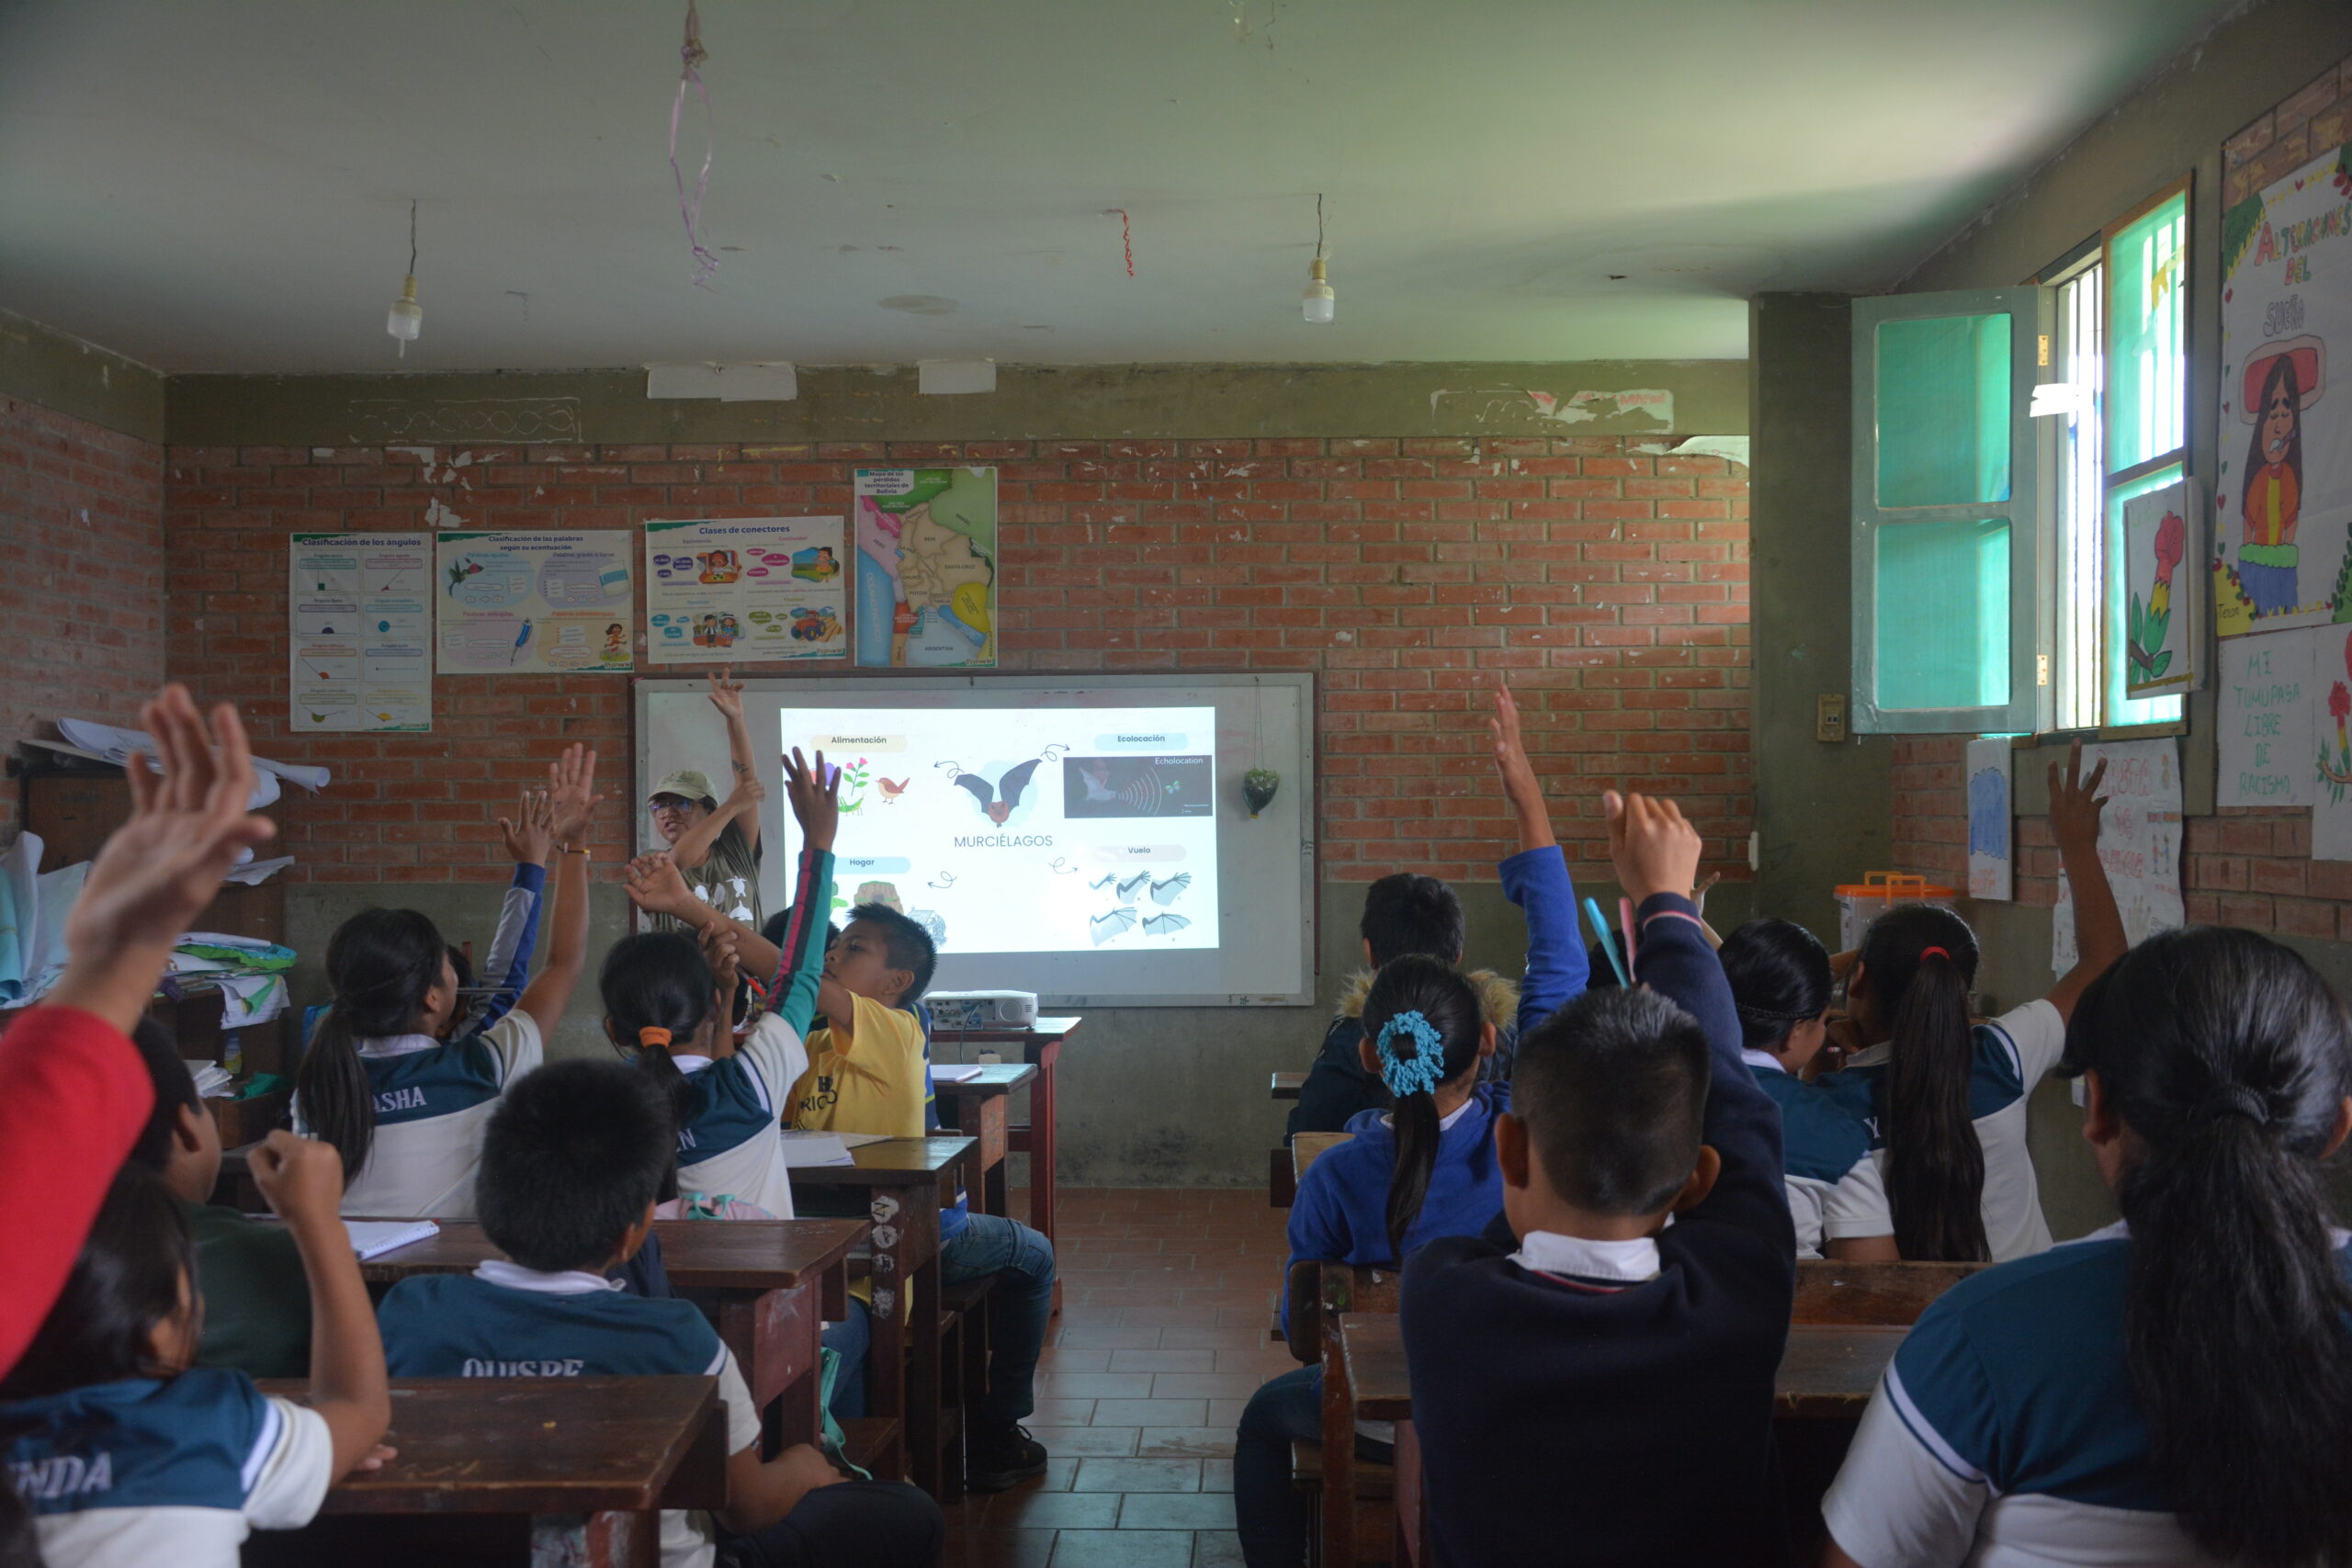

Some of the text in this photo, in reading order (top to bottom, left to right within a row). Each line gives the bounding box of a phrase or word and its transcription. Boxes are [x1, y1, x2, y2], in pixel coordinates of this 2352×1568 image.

[2284, 255, 2312, 286] DEL
[2263, 294, 2306, 337] SUEÑO
[387, 538, 421, 547] ángulos
[2247, 649, 2273, 679] MI
[2244, 713, 2283, 738] LIBRE
[831, 736, 888, 744] Alimentación
[1116, 734, 1166, 743] Ecolocación
[1155, 756, 1204, 765] Echolocation
[2255, 743, 2271, 768] DE
[954, 833, 1054, 848] MURCIÉLAGOS
[1127, 846, 1151, 854] Vuelo
[849, 858, 876, 868] Hogar
